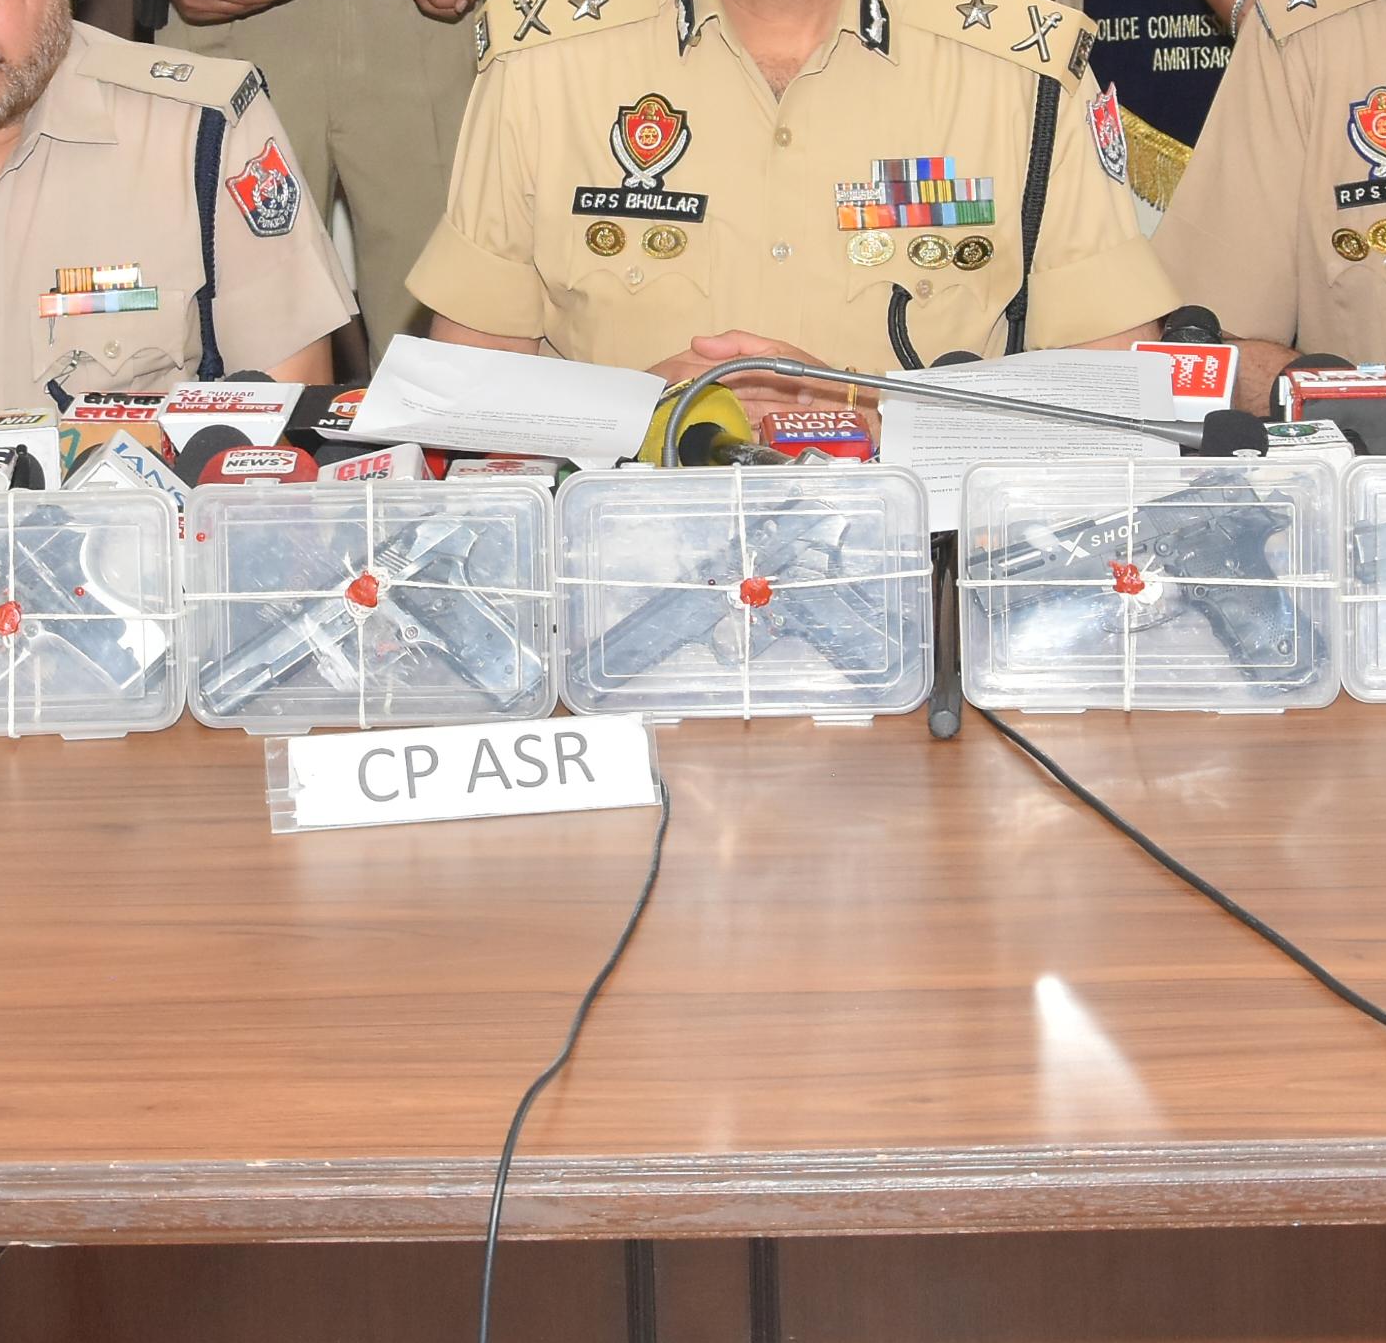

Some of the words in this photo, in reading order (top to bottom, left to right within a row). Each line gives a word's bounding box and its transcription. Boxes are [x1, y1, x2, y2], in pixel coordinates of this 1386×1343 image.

[1153, 46, 1230, 71] AMRITSAR
[625, 193, 700, 214] BHULLAR
[772, 412, 857, 421] LIVING
[775, 420, 857, 430] INDIA
[225, 457, 280, 468] NEWS
[337, 454, 391, 480] GTC
[1091, 520, 1142, 548] SHOT
[357, 744, 440, 803] CP
[466, 731, 596, 794] ASR
